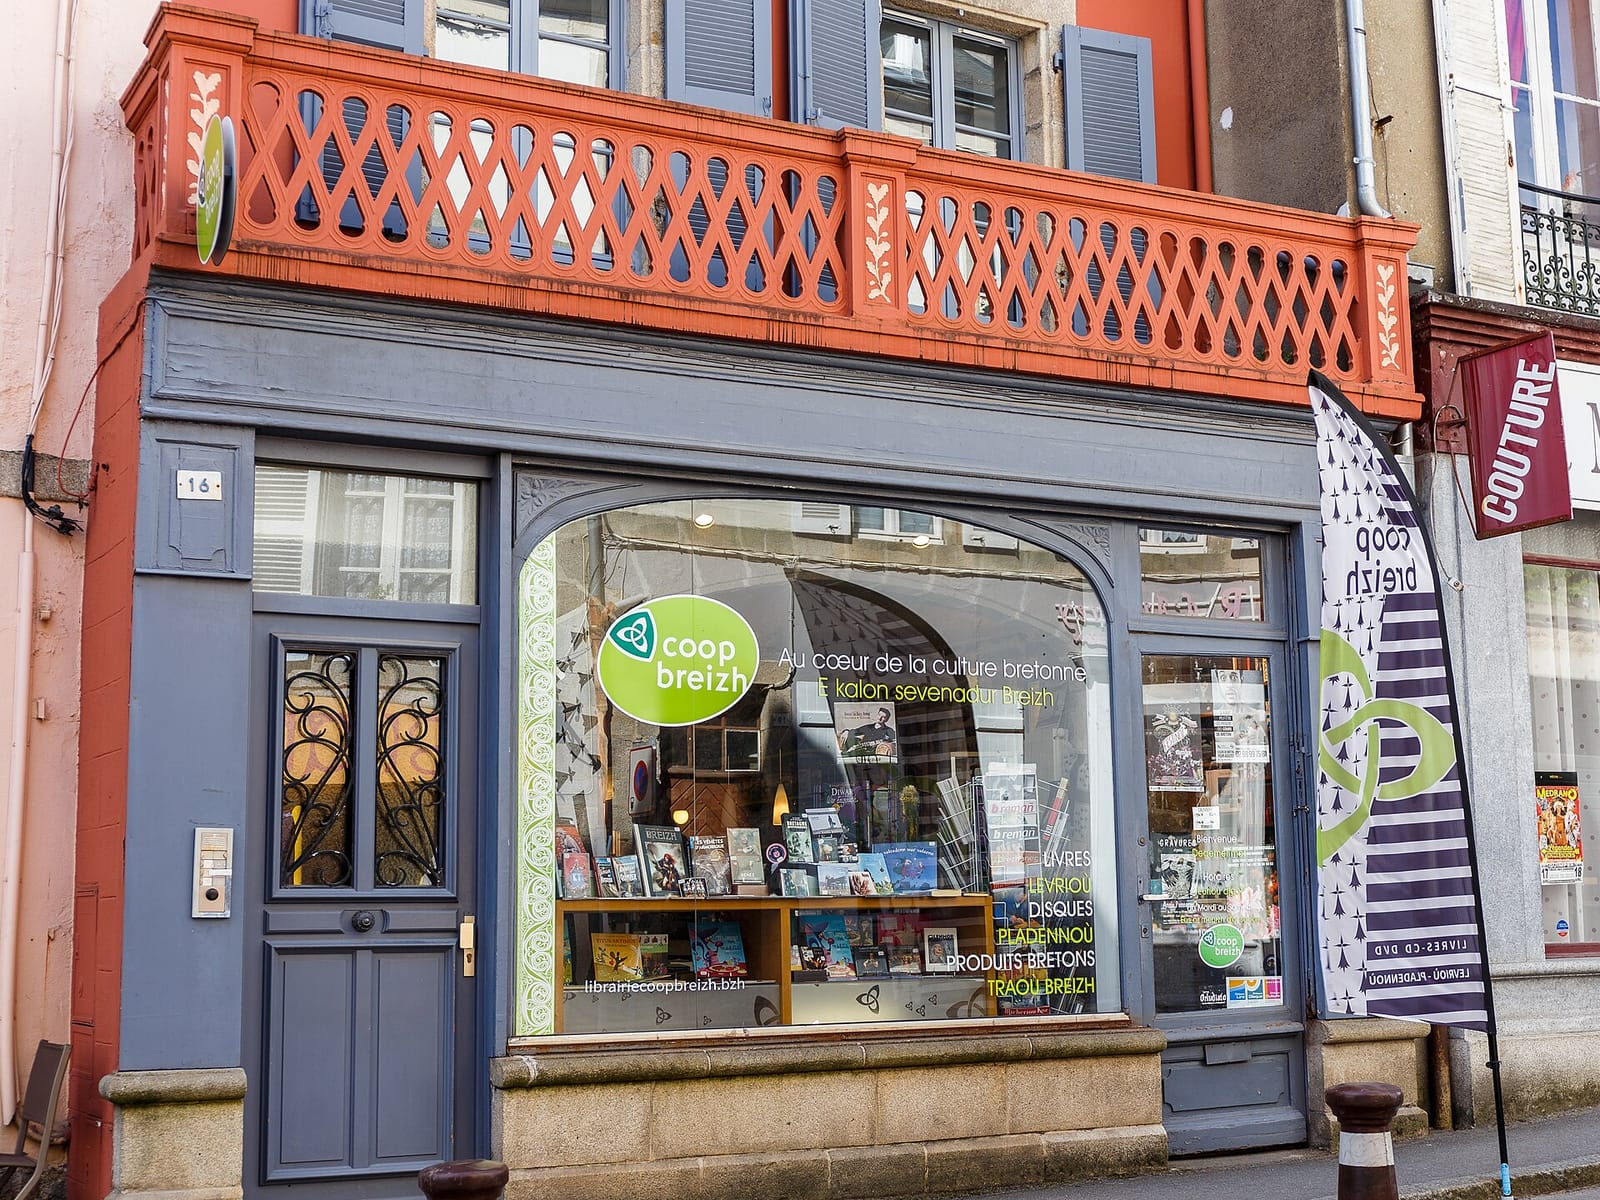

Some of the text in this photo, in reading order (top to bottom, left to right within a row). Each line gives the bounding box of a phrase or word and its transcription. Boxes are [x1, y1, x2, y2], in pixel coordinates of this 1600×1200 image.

[1481, 358, 1555, 524] COUTURE
[189, 477, 209, 493] 16
[662, 637, 736, 667] coop
[778, 648, 1087, 682] Au cœur de la culture bretonne
[656, 661, 747, 692] breizh
[818, 677, 1054, 707] E kalon sevenadur Breizh
[1536, 787, 1578, 800] MEDRANO
[645, 830, 677, 841] BREIZH
[1197, 835, 1238, 844] Bienvenue
[1043, 850, 1092, 867] LIVRES
[1541, 868, 1549, 879] 17
[1574, 866, 1583, 878] 18
[1029, 873, 1091, 894] LEVRIOÙ
[1029, 901, 1093, 918] DISQUES
[1198, 903, 1216, 912] Mardi
[998, 922, 1093, 945] PLADENNOÙ
[1215, 946, 1241, 956] breizh
[1216, 938, 1238, 947] coop
[946, 950, 1095, 972] PRODUITS BRETONS
[584, 977, 745, 995] librairiecoopbreizh.bzh
[988, 974, 1095, 997] TRAOÙ BREIZH
